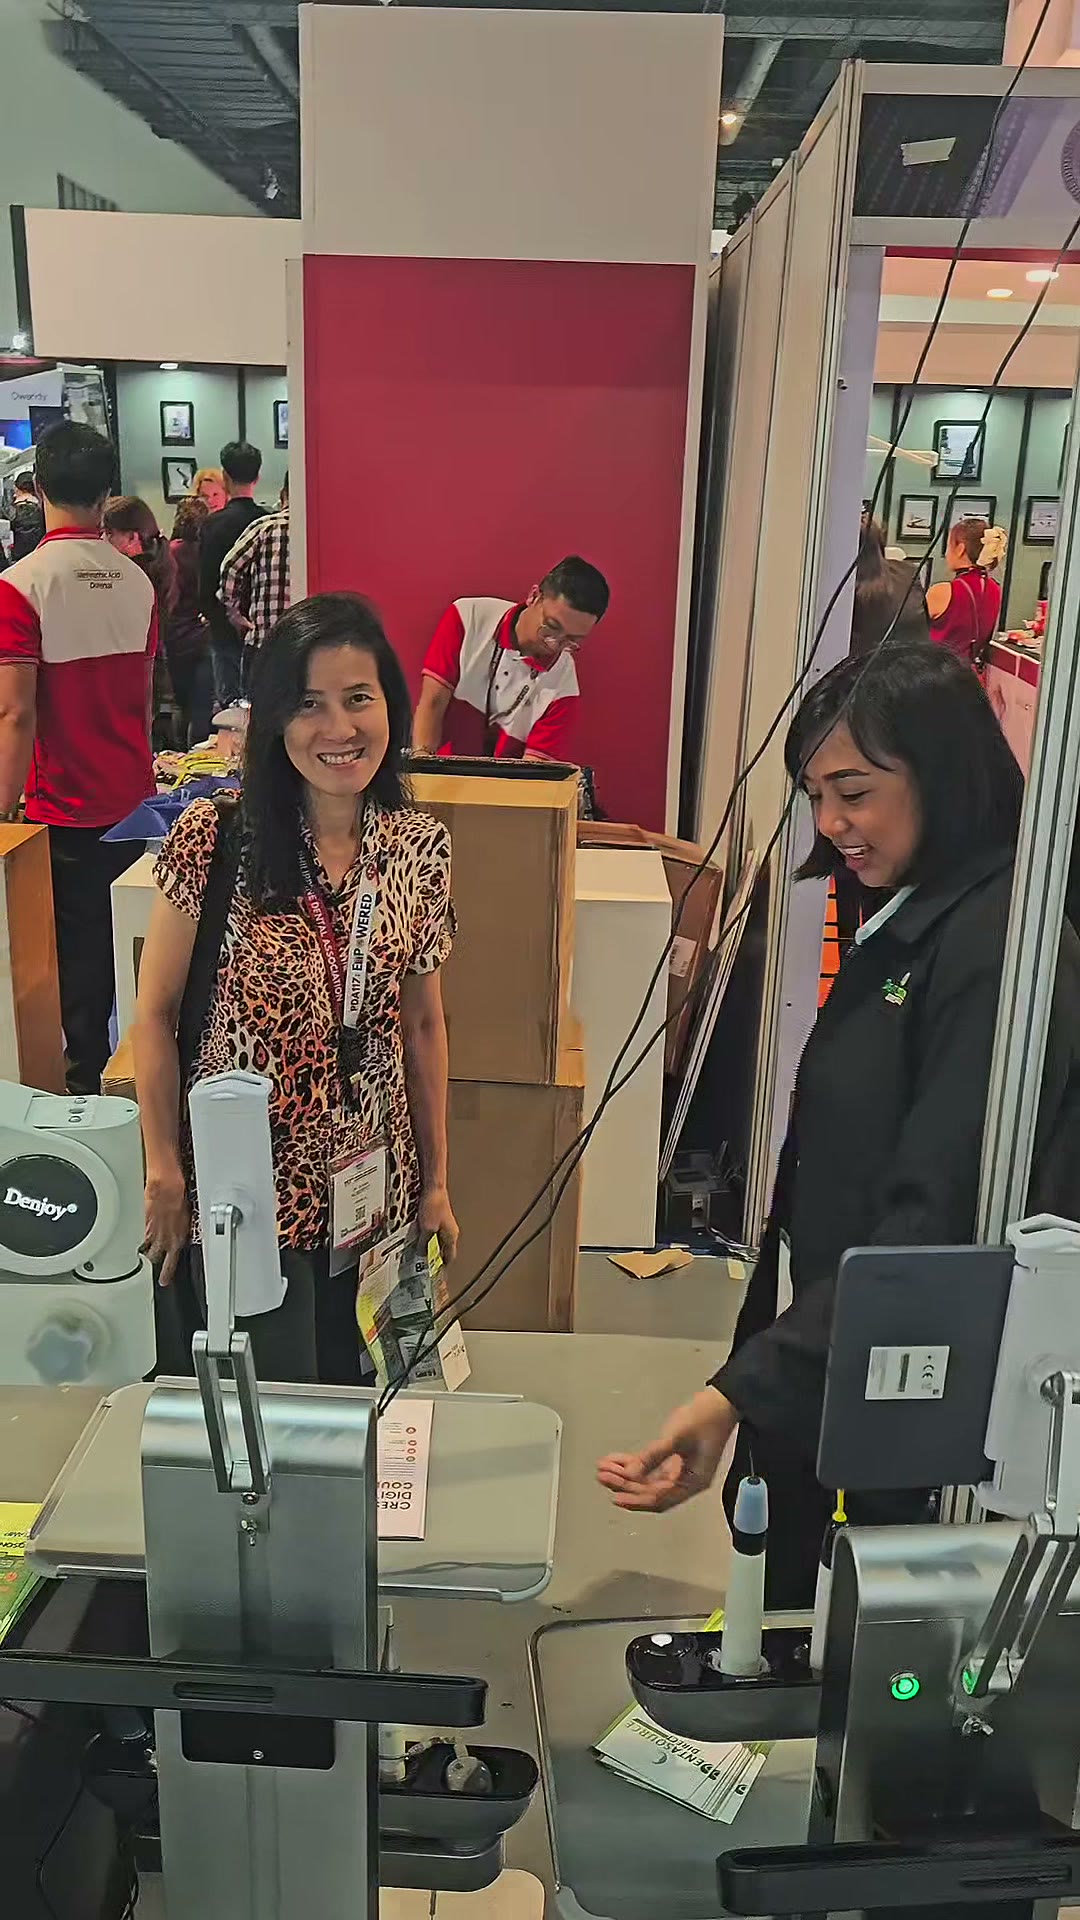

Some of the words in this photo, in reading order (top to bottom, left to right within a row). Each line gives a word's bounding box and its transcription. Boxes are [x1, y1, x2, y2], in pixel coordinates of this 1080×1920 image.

[352, 893, 372, 971] EPWERED
[310, 901, 328, 940] DENTAL
[322, 938, 344, 1002] ASSOCIATION
[3, 1187, 67, 1221] Denjoy
[377, 1481, 413, 1490] COU
[378, 1491, 412, 1500] DIGI
